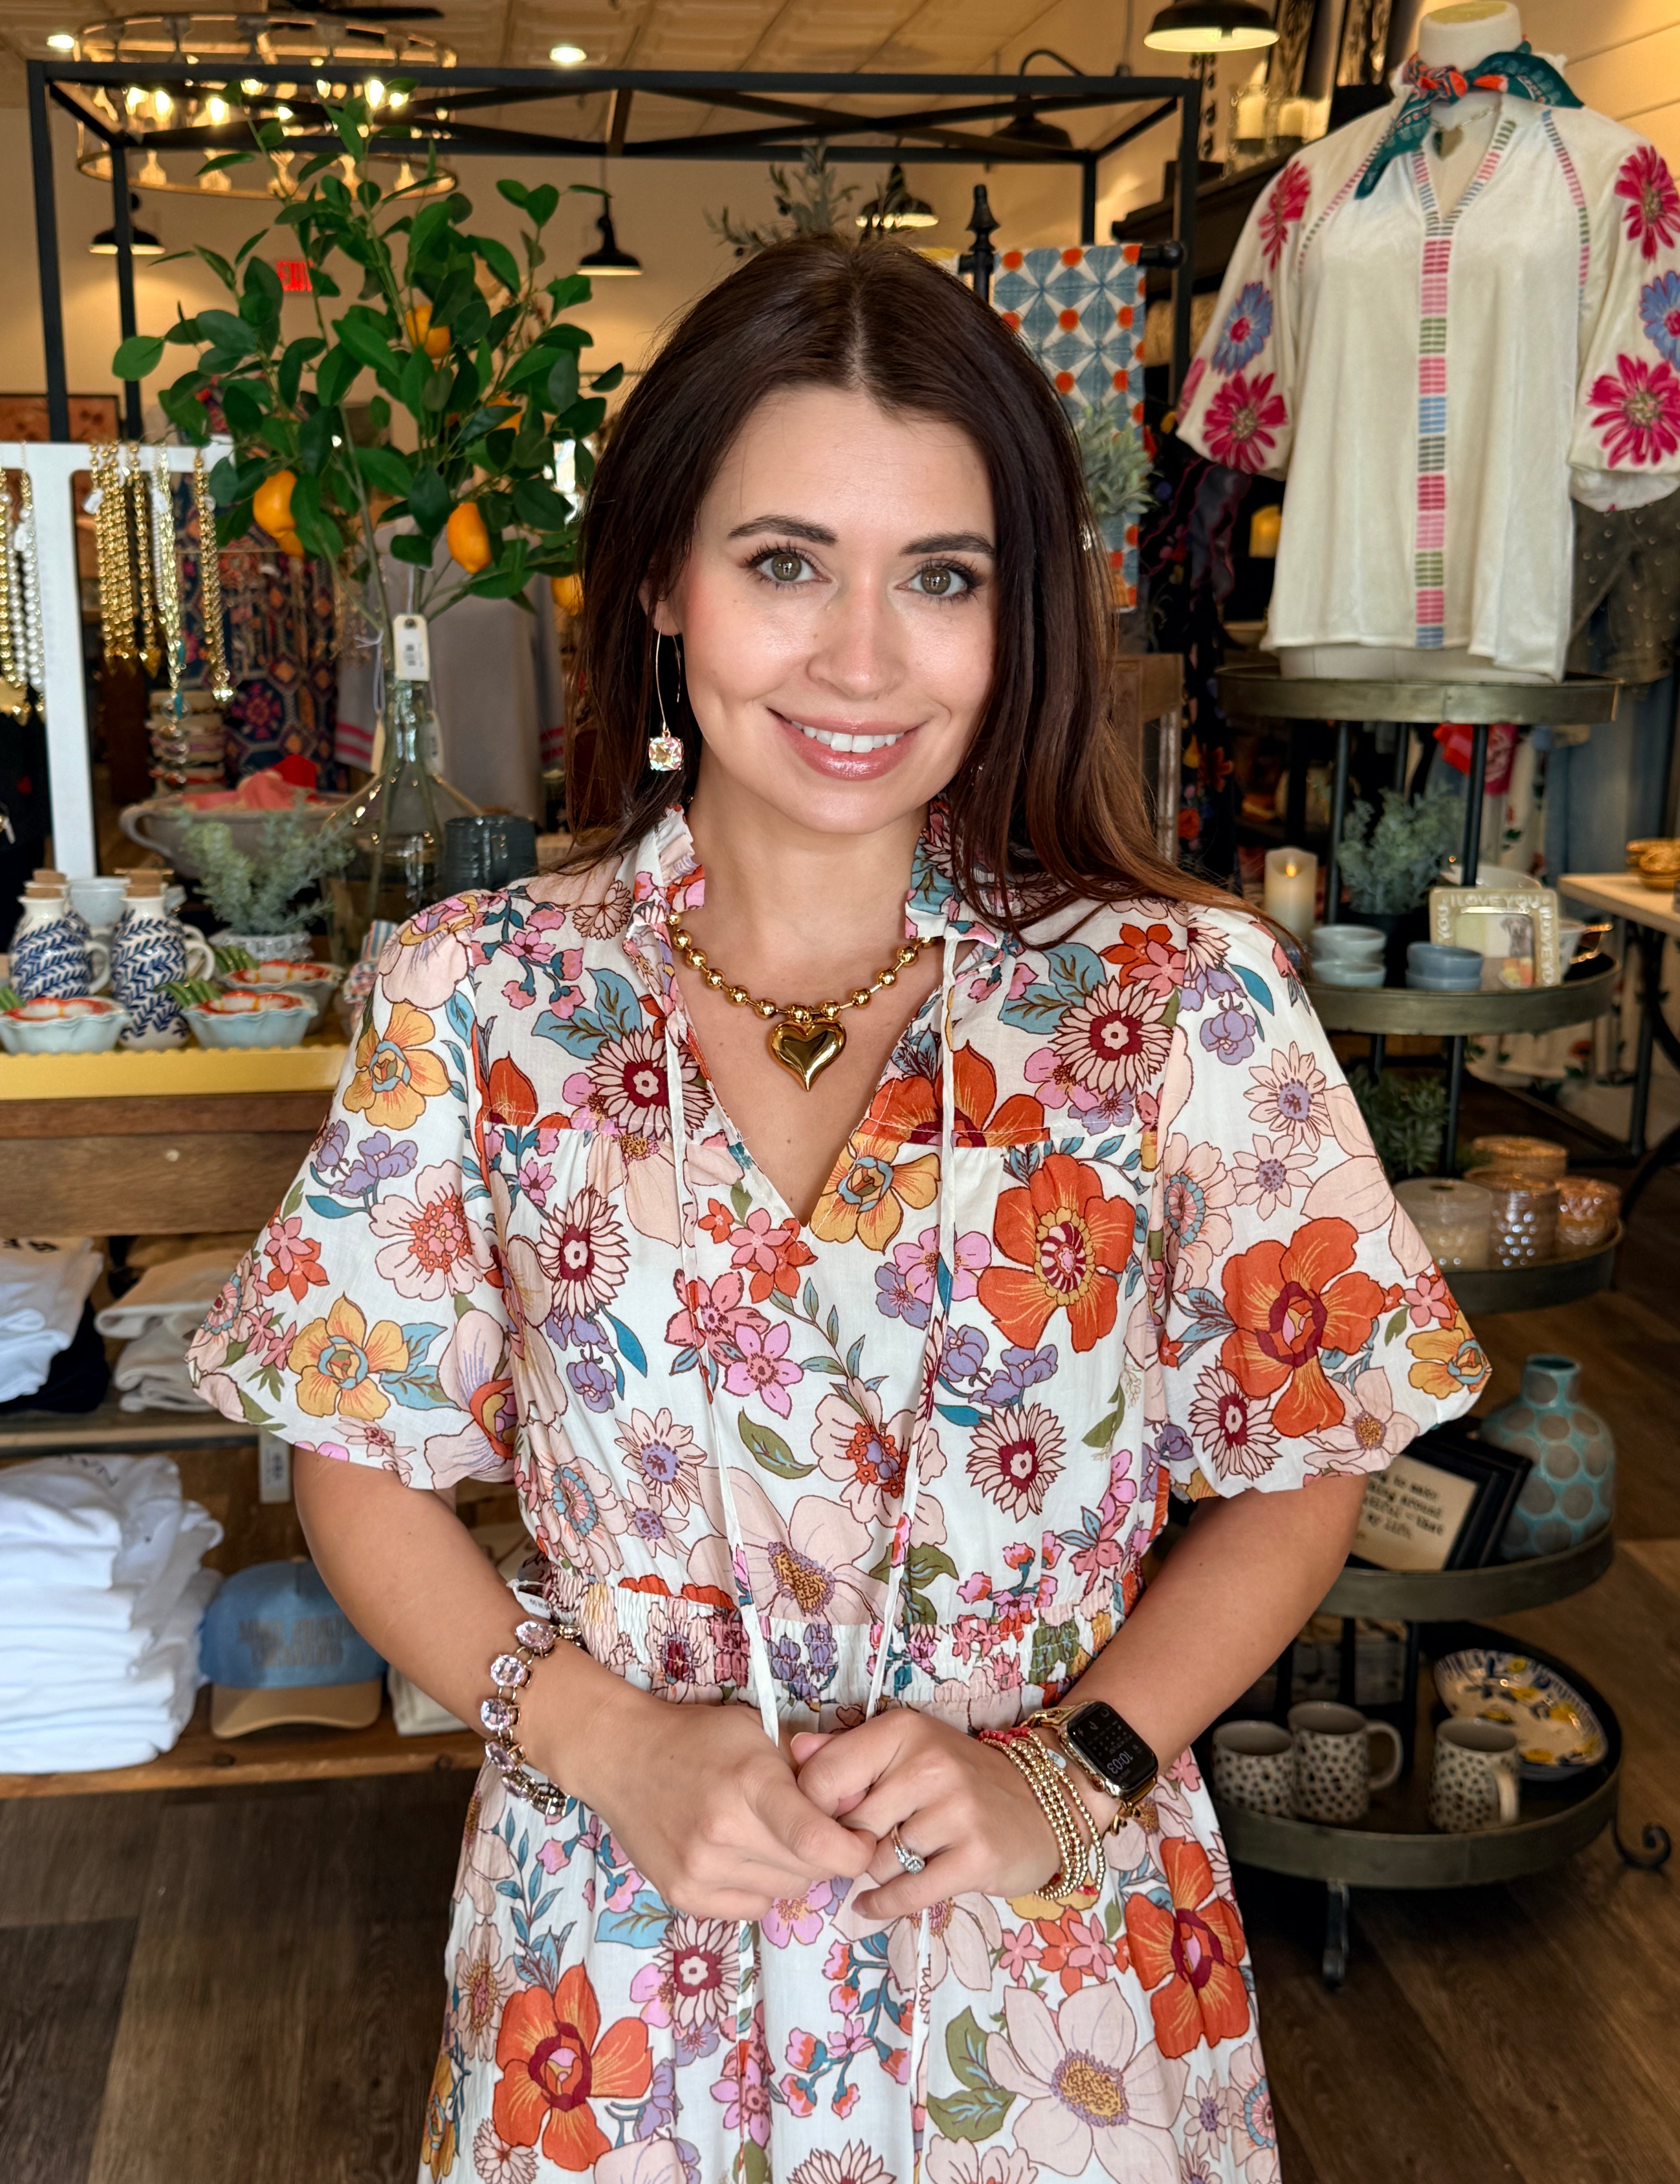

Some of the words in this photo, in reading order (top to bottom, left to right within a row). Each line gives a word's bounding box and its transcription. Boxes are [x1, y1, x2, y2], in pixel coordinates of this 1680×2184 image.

[1456, 894, 1502, 908] LOVE
[1504, 894, 1539, 908] YOU
[1107, 1751, 1133, 1774] 10:03
